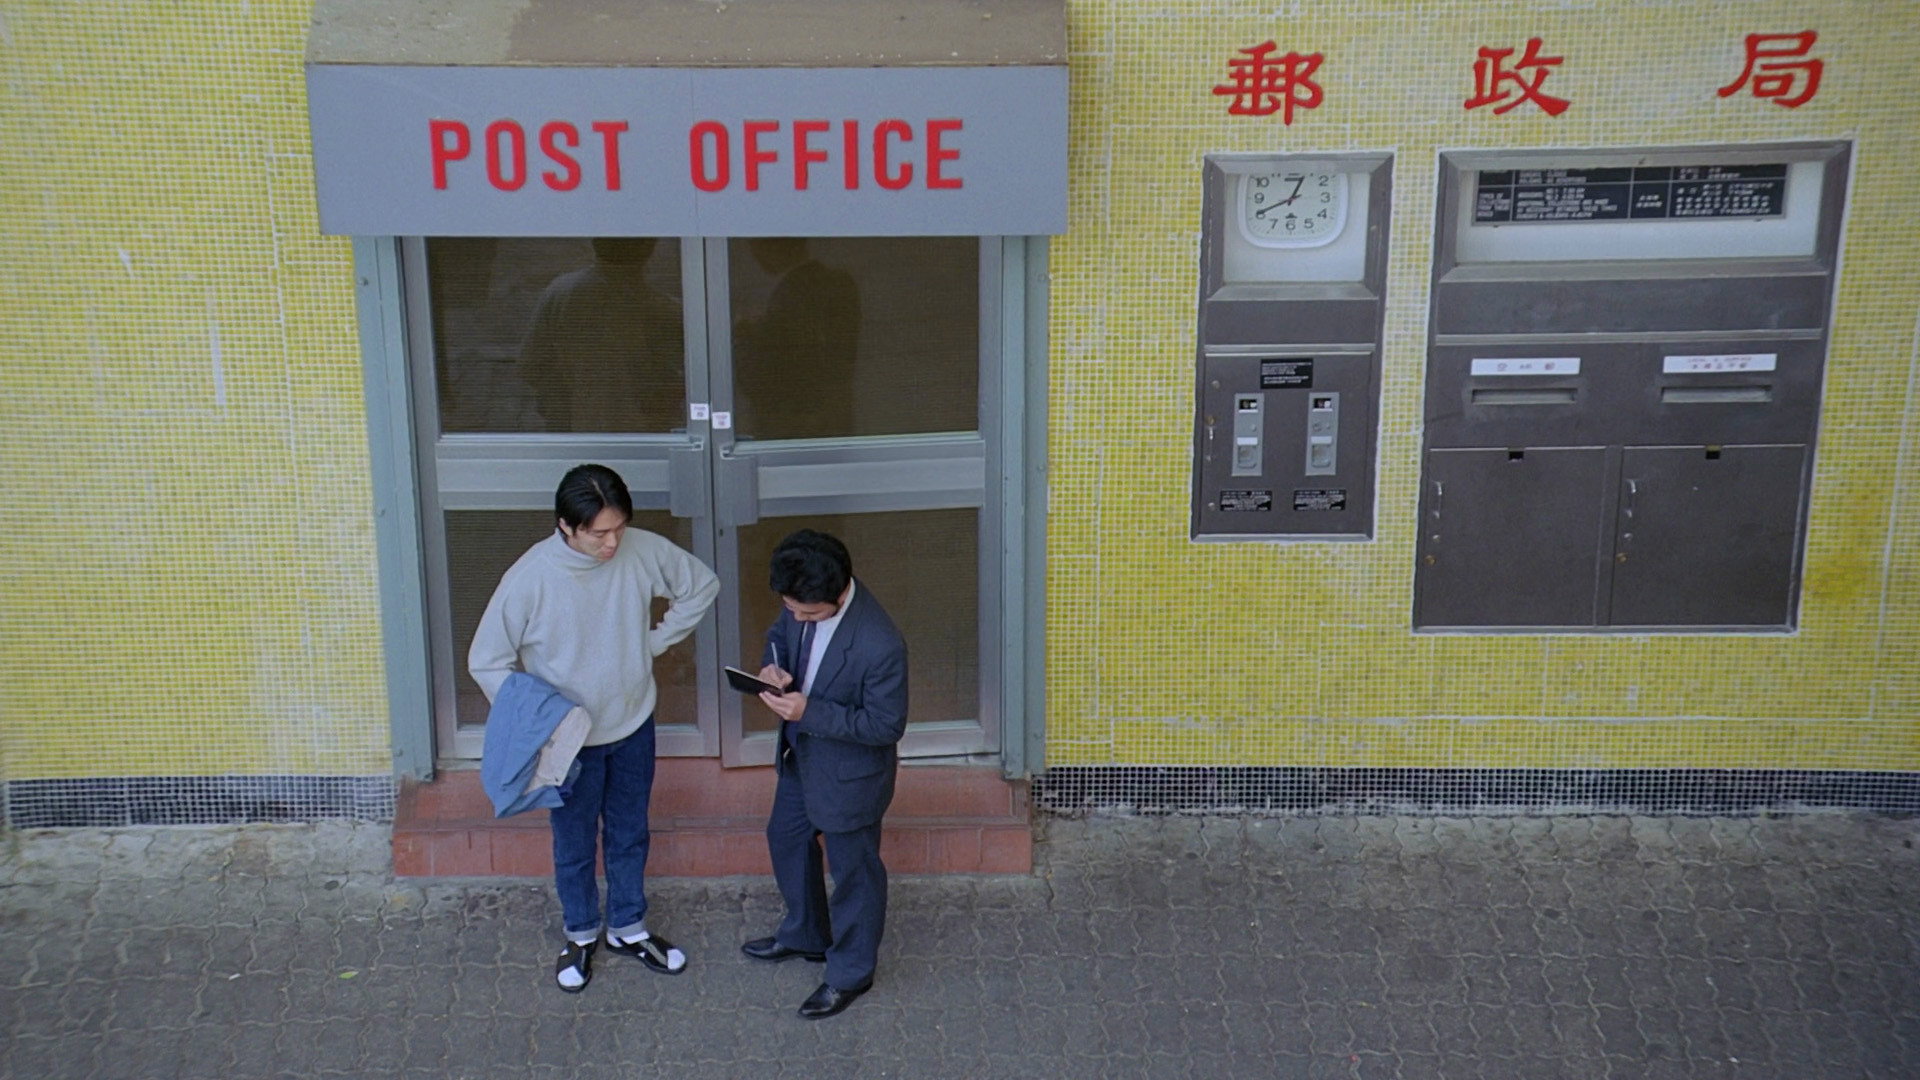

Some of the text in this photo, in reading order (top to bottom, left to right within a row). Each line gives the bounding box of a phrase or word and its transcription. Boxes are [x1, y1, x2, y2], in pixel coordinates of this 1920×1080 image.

[1213, 32, 1823, 124] 郵政局
[430, 119, 962, 192] POST OFFICE
[1256, 176, 1269, 188] 10
[1319, 175, 1329, 187] 2
[1254, 192, 1265, 204] 9
[1321, 192, 1331, 203] 3
[1317, 208, 1327, 219] 4
[1269, 219, 1279, 229] 7
[1285, 219, 1296, 231] 6
[1304, 219, 1314, 229] 5
